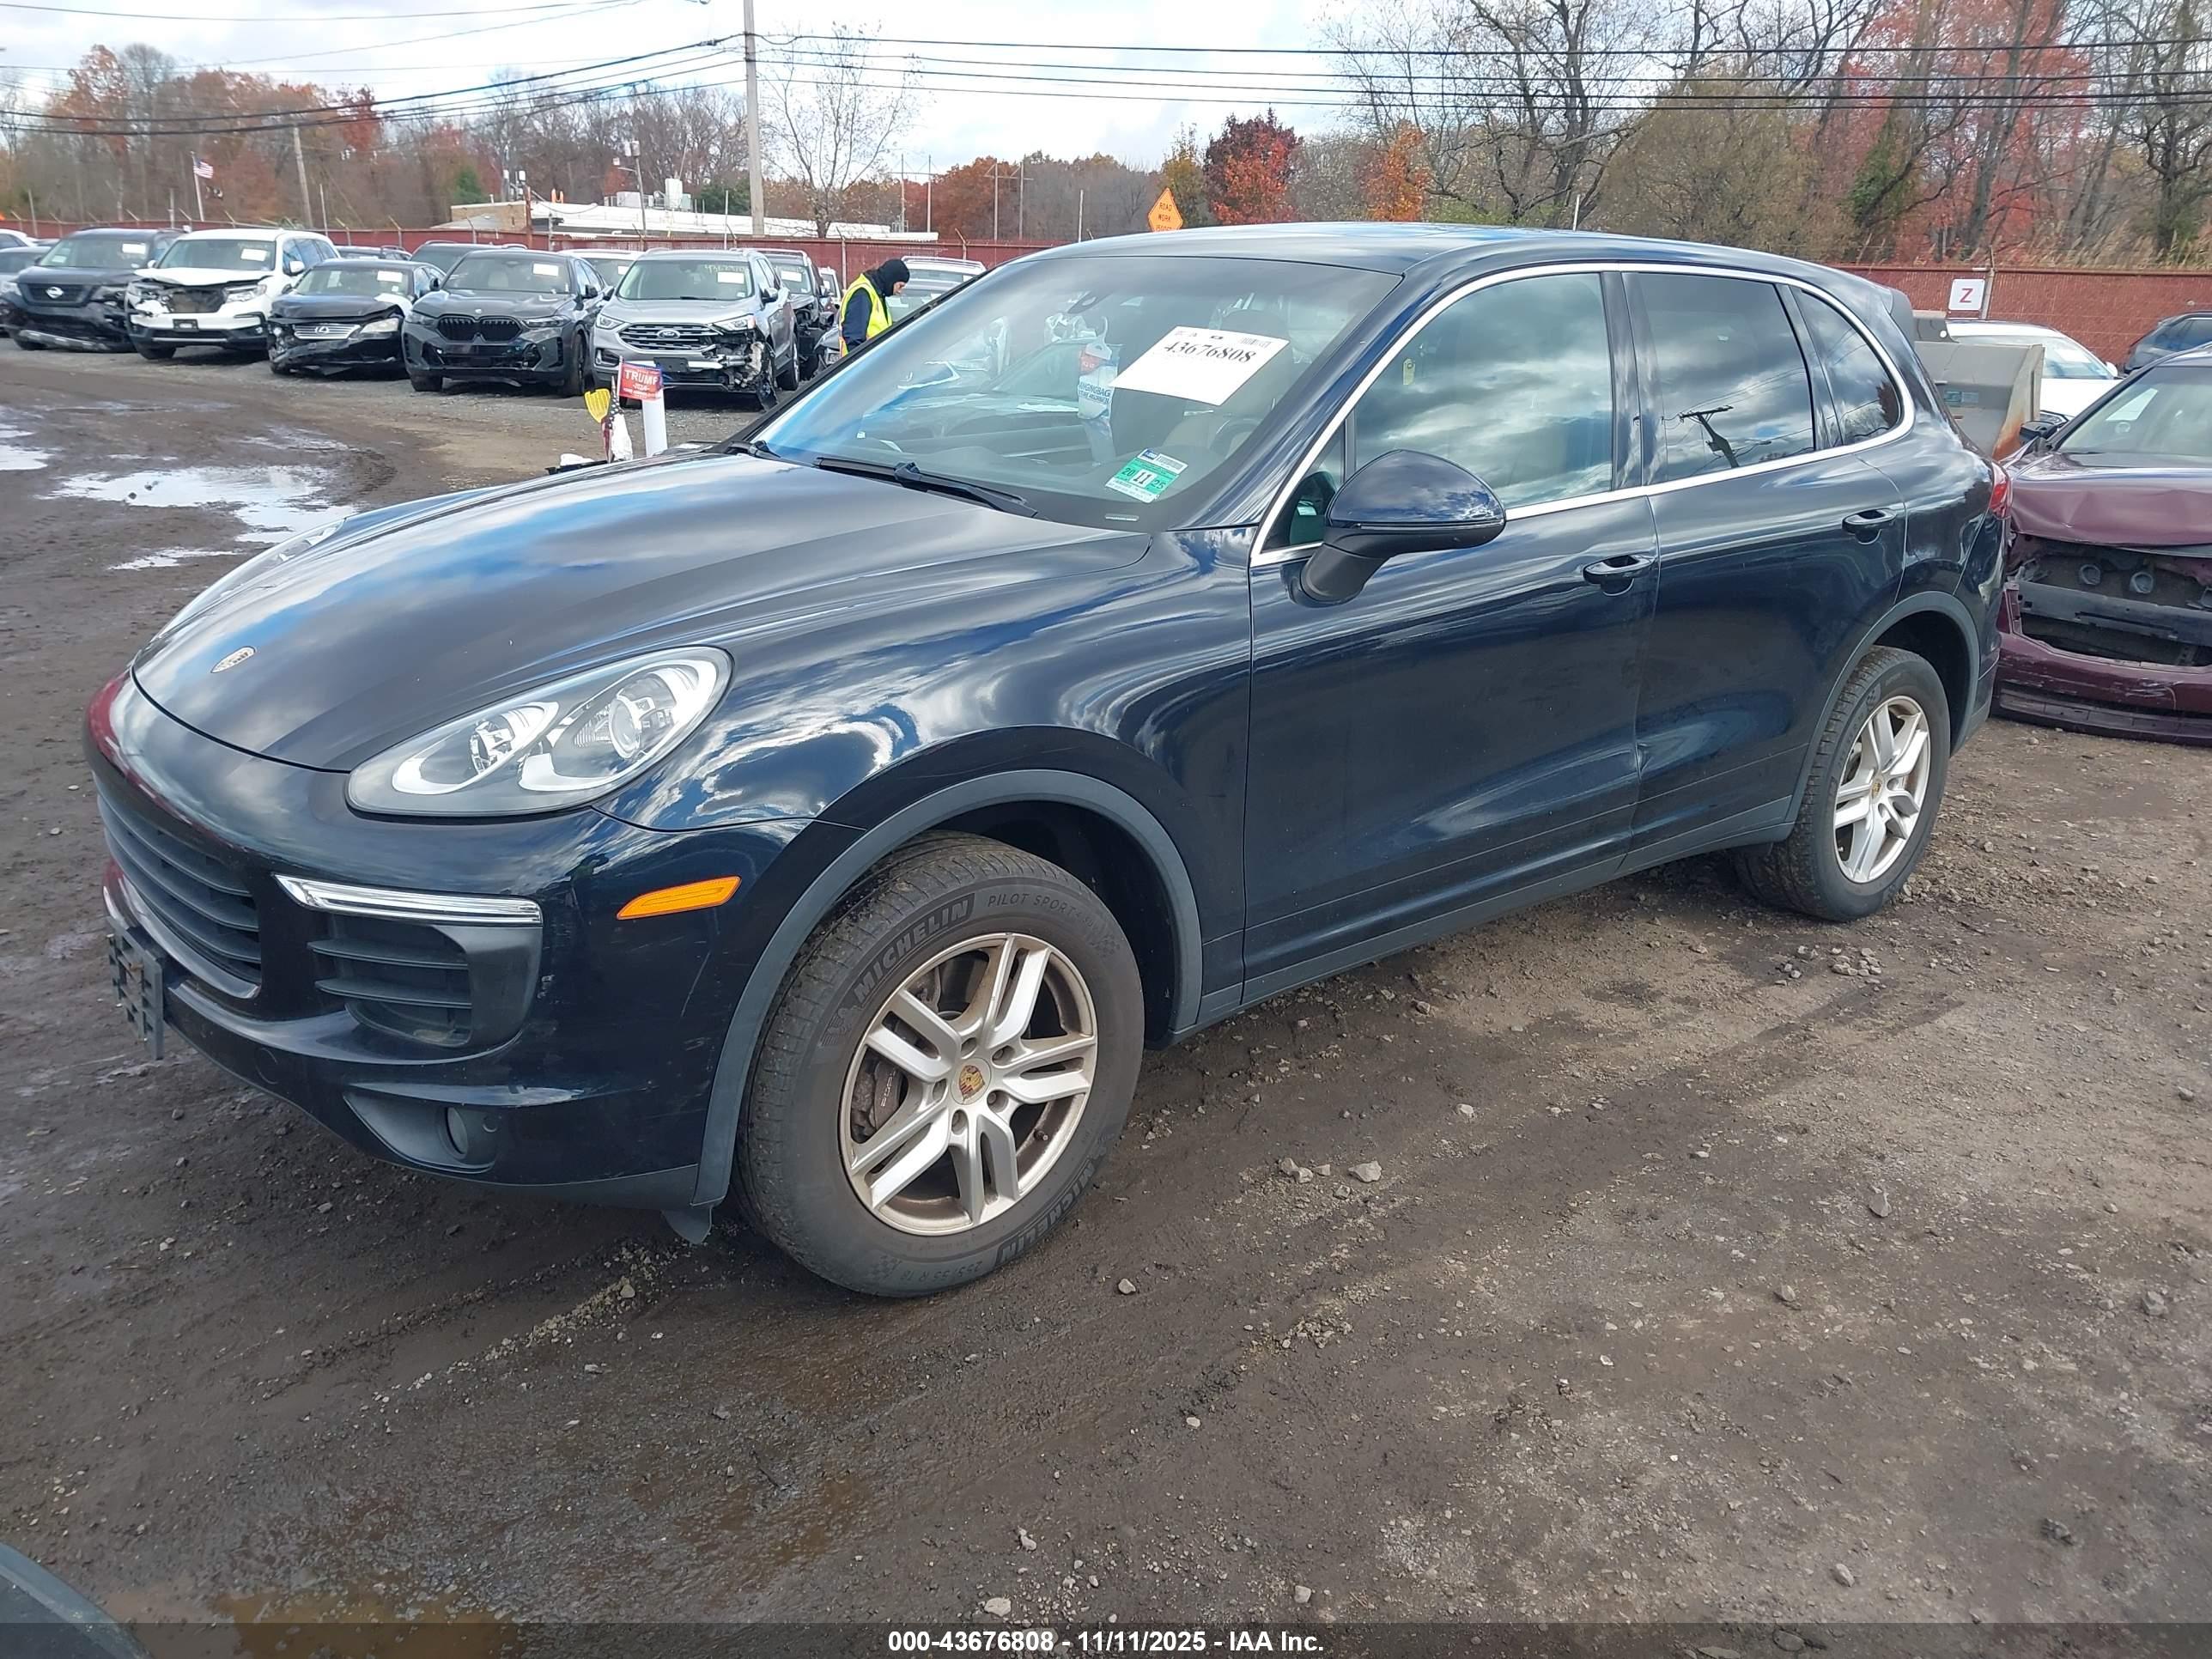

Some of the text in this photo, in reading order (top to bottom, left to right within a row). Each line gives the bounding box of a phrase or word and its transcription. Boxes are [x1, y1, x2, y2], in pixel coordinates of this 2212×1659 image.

[1959, 288, 1973, 303] Z
[1164, 340, 1256, 363] 43676808
[624, 369, 659, 386] TRUMP
[1121, 467, 1135, 477] 20
[1133, 471, 1152, 484] 11
[988, 893, 1030, 908] PILOT
[1033, 895, 1077, 916] SPORT
[854, 899, 969, 1003] MICHELIN
[1000, 1162, 1097, 1264] MICHELIN
